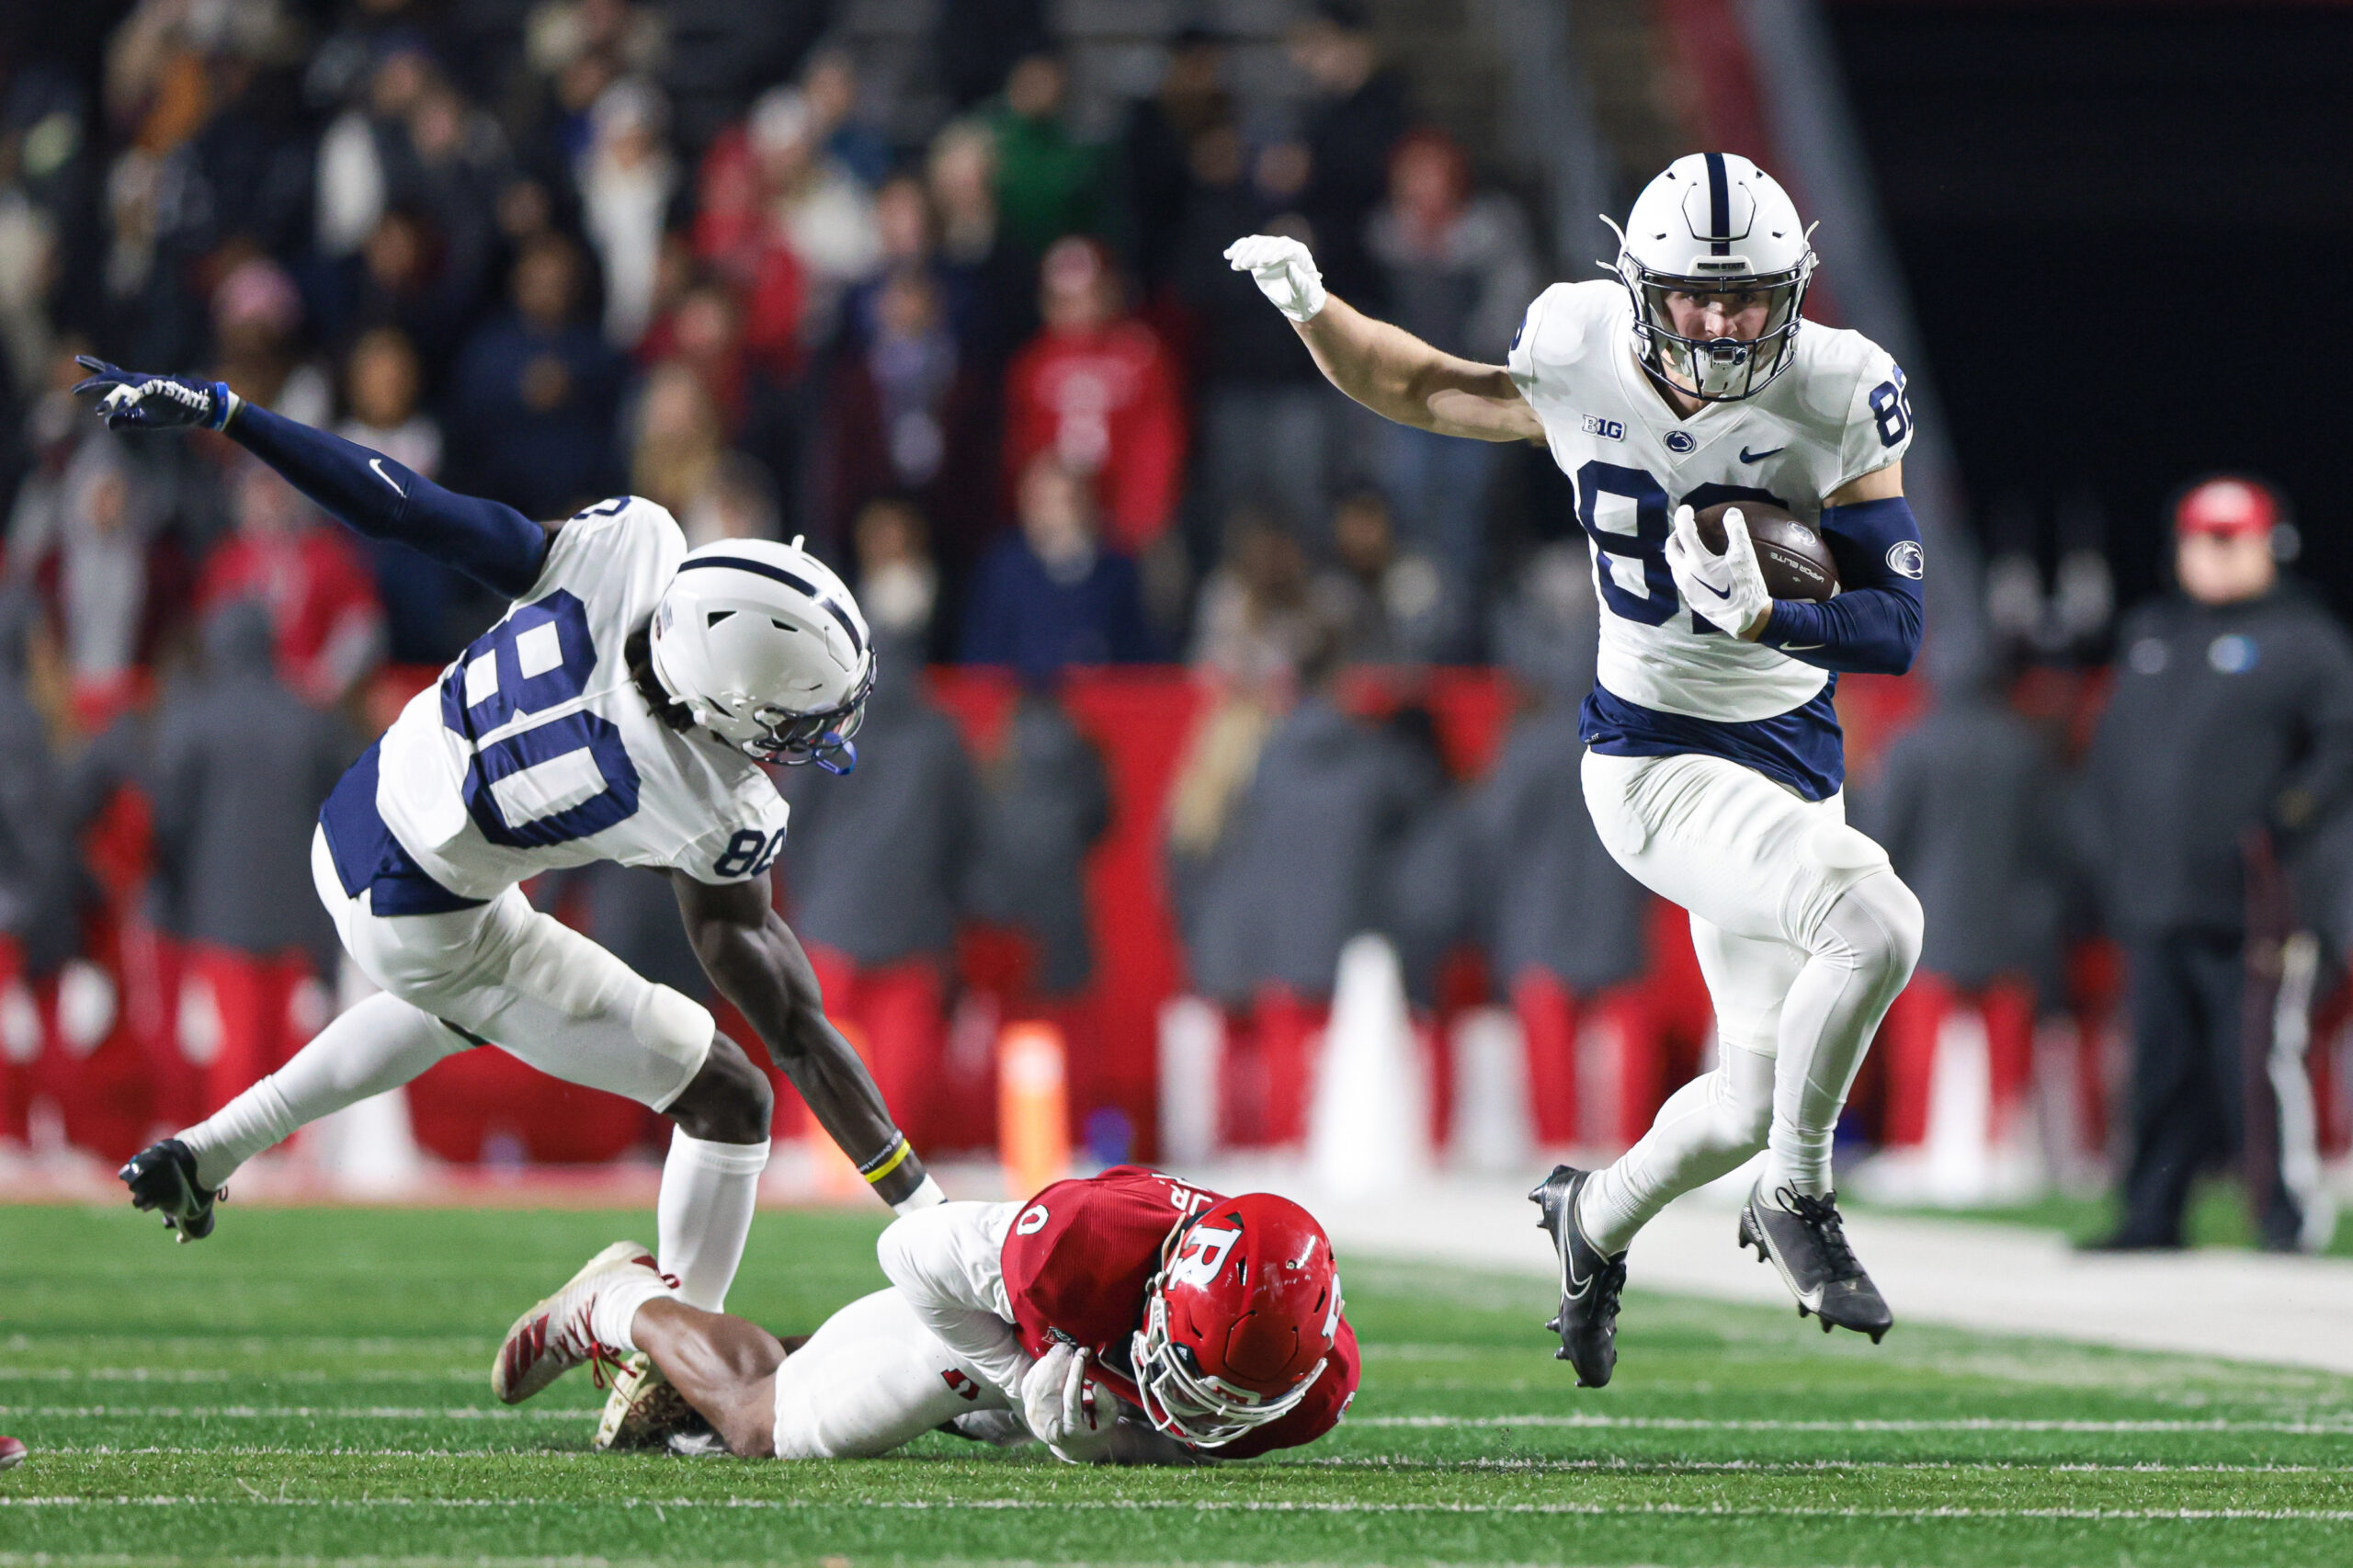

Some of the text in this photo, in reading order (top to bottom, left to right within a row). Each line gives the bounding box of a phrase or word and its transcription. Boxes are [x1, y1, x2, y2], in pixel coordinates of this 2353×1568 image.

[1770, 551, 1800, 569] ELITE
[441, 588, 641, 849] 80
[1167, 1223, 1243, 1291] R
